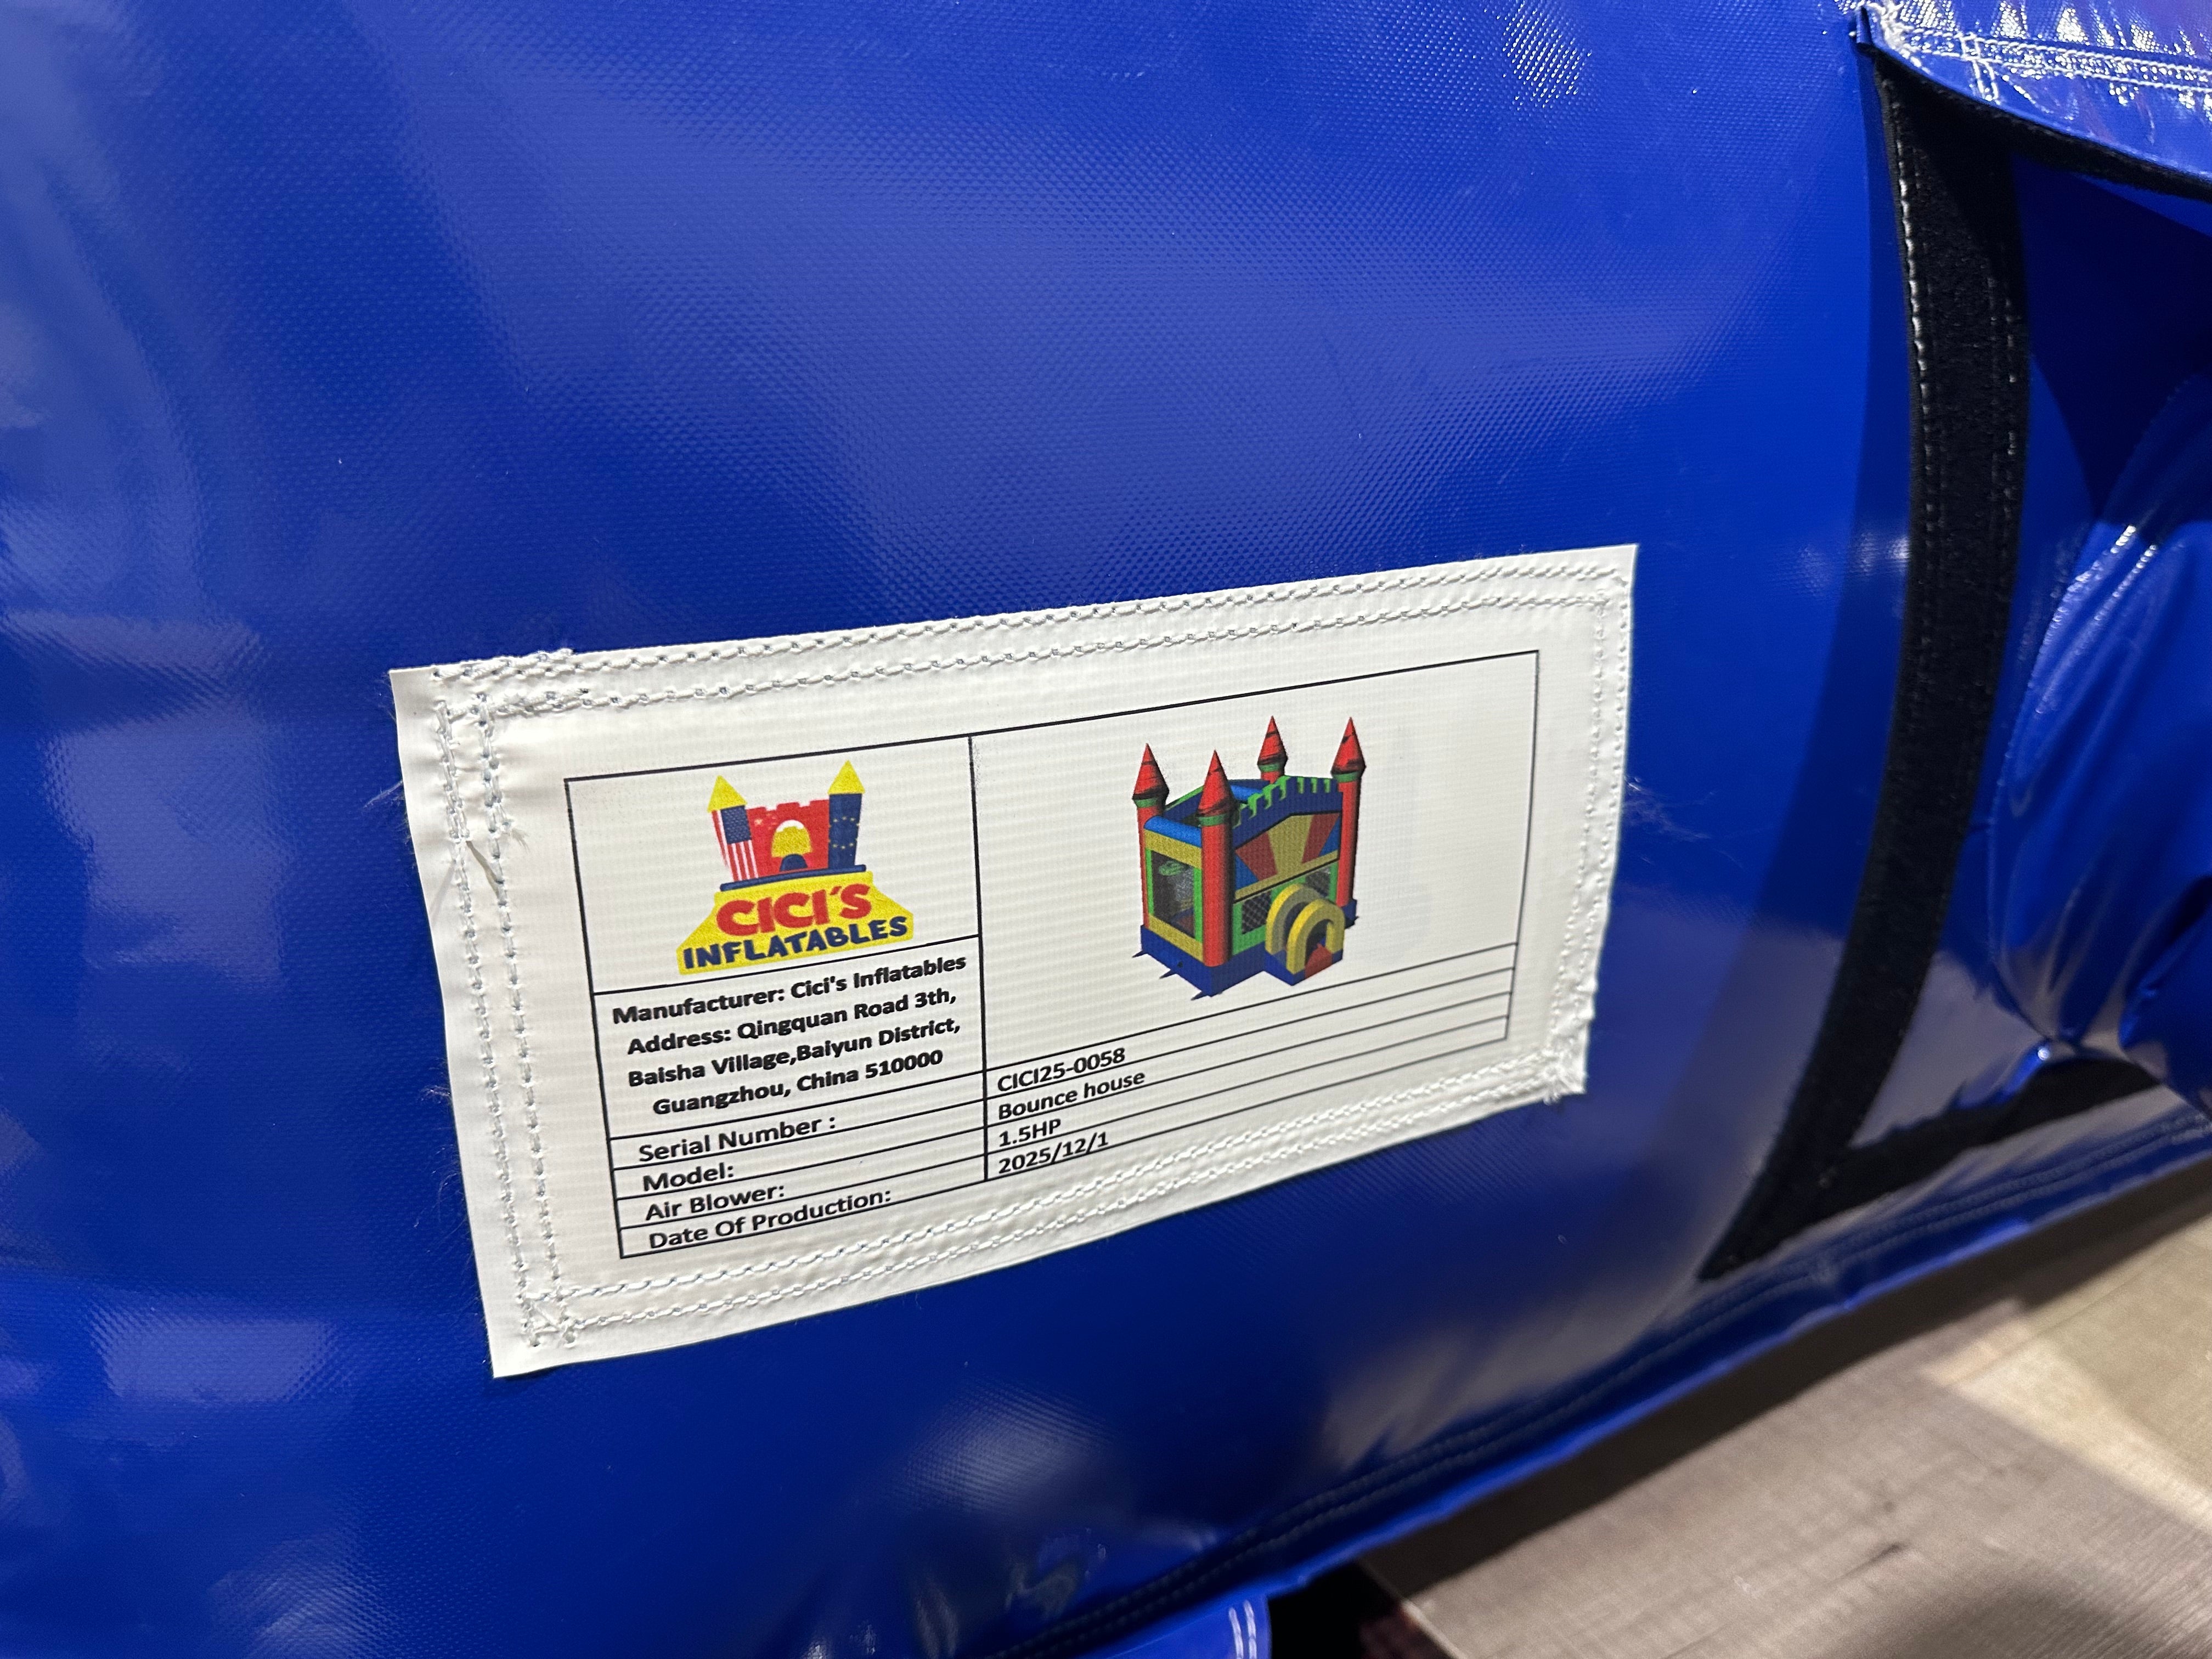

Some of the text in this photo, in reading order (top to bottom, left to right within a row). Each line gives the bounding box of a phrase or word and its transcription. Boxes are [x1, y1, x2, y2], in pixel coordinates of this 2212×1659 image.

[716, 883, 872, 936] CICI'S
[684, 916, 907, 969] INFLATABLES
[613, 956, 966, 1024] Manufacturer: Cici's Inflatables
[628, 988, 956, 1054] Address: Qingquan Road 3th,
[629, 1018, 960, 1087] Baisha Village,Baiyun District,
[998, 1047, 1125, 1091] CICI25-0058
[653, 1049, 943, 1115] Guangzhou, China 510000
[999, 1072, 1146, 1120] Bounce house
[639, 1135, 711, 1162] Serial
[999, 1118, 1061, 1147] 1.5HP
[999, 1132, 1108, 1173] 2025/12/1
[643, 1163, 734, 1192] Model:
[646, 1185, 785, 1221] Air Blower:
[650, 1189, 891, 1249] Date Of Production:
